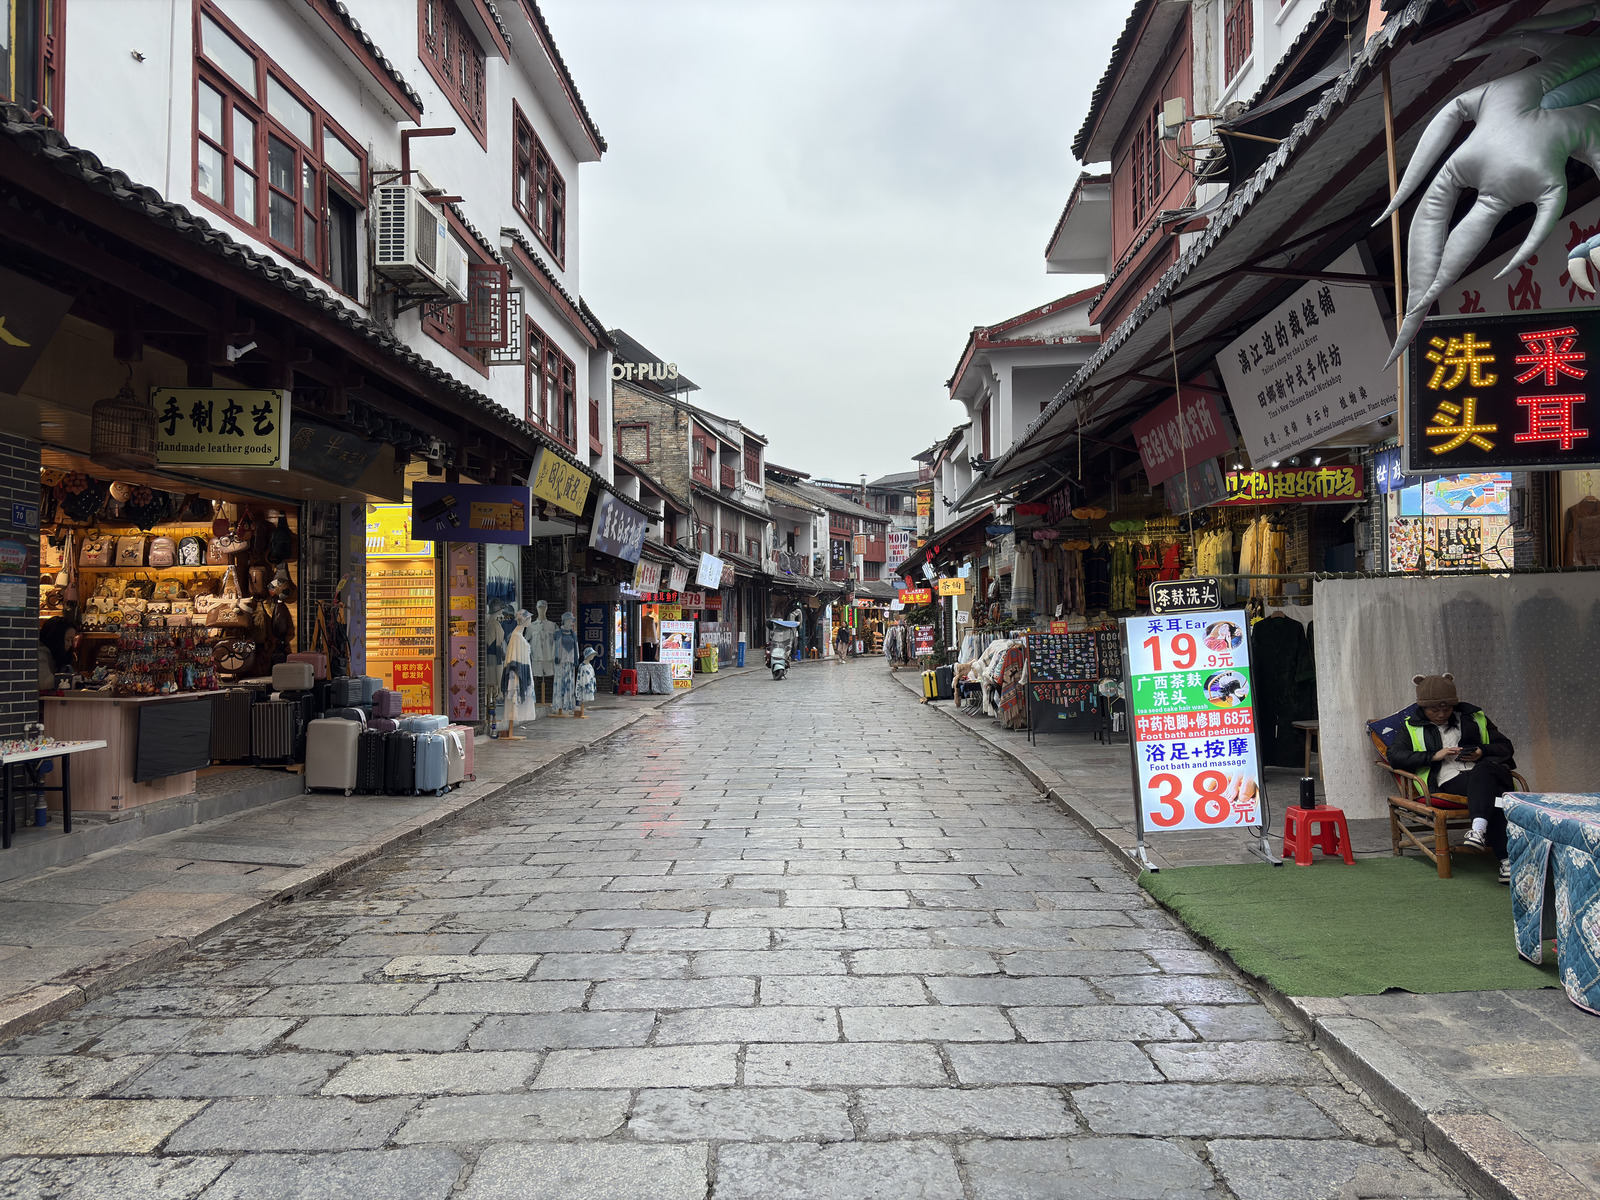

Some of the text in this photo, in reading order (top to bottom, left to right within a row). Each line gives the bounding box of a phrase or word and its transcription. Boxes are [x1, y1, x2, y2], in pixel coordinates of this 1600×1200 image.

[1237, 285, 1336, 375] 漓江边的裁缝铺
[1276, 356, 1287, 364] shop
[1286, 352, 1293, 360] by
[1292, 346, 1300, 356] the
[1304, 334, 1318, 348] River
[1280, 402, 1290, 413] New
[1288, 395, 1306, 408] Chinese
[1304, 386, 1318, 398] Hand
[1316, 374, 1342, 392] Workshop
[1424, 331, 1499, 456] 洗头
[1513, 325, 1589, 451] 采耳
[159, 396, 275, 437] 手制皮艺
[1368, 401, 1380, 412] Plant
[158, 442, 272, 456] Handmade leather goods
[16, 512, 24, 520] 70
[888, 533, 908, 543] MOJO
[1157, 586, 1216, 608] 茶麸洗头
[584, 608, 604, 642] 漫画
[1147, 618, 1207, 634] 采耳 Ear
[1143, 632, 1234, 672] 19.9元
[402, 671, 424, 679] 都发财
[1137, 672, 1202, 692] 广西茶麸
[1153, 688, 1188, 707] 洗头
[1138, 710, 1251, 732] 中药泡脚+修脚 68元
[1164, 731, 1186, 739] bath
[1208, 727, 1249, 737] pedicure
[1145, 737, 1249, 762] 浴足+按摩
[1150, 758, 1246, 771] Foot bath and massage
[1147, 770, 1255, 828] 38元
